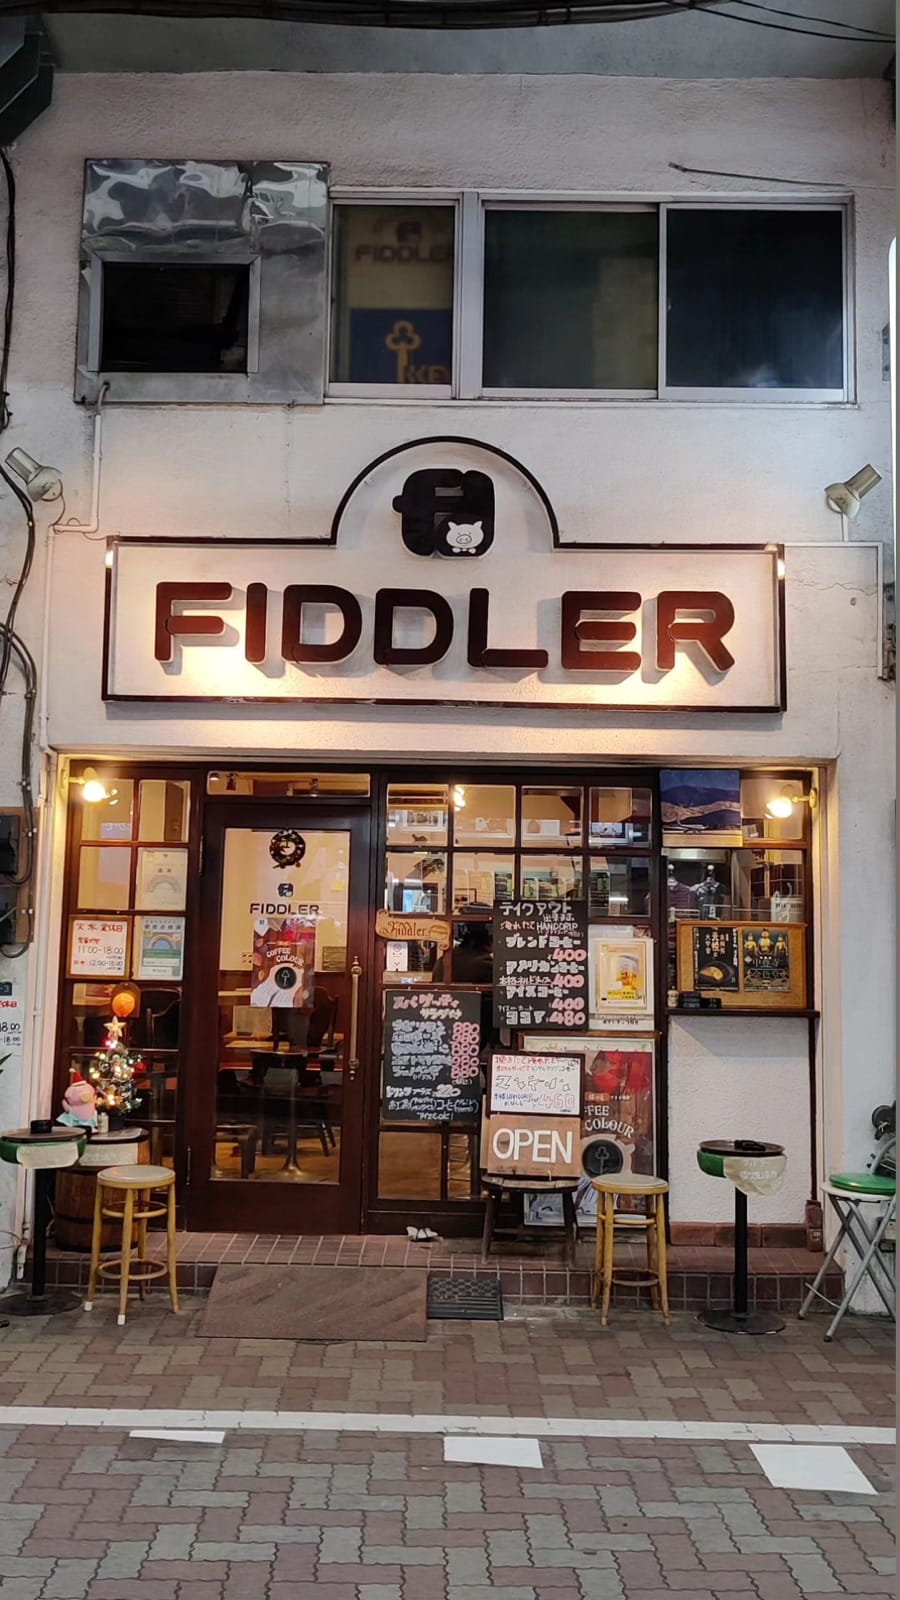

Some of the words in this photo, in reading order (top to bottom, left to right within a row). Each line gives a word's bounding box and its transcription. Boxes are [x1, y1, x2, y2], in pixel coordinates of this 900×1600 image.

[155, 581, 735, 671] FIDDLER
[250, 903, 319, 915] FIDDLER
[499, 902, 571, 916] テイクアウト
[387, 920, 428, 937] Fiddler
[506, 933, 581, 948] ブレンドコーヒー
[506, 985, 569, 999] アイスコーヒー
[506, 1011, 546, 1025] ココア
[585, 1105, 609, 1117] FEE
[584, 1118, 634, 1139] COLOUR
[493, 1128, 572, 1164] OPEN
